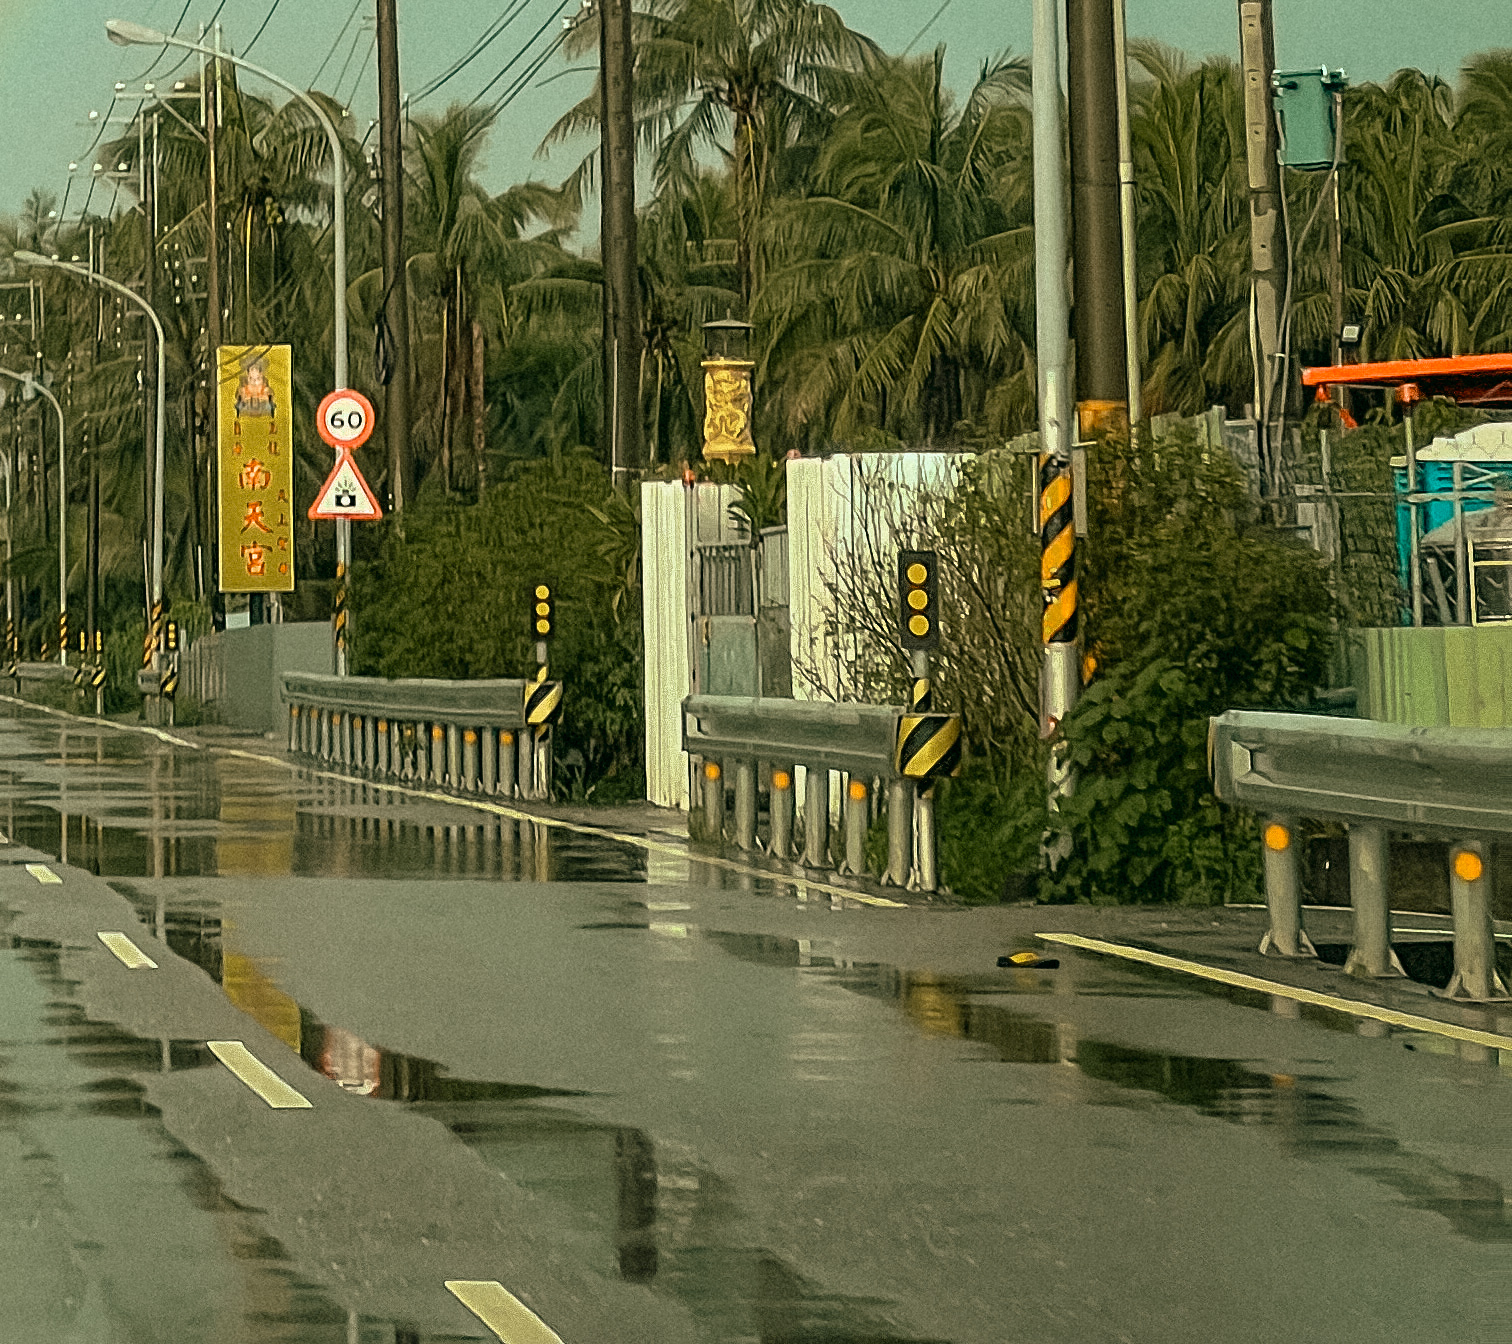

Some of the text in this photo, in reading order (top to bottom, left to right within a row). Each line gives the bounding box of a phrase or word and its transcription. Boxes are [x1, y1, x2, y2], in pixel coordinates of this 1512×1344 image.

[330, 410, 363, 429] 60
[238, 458, 273, 576] 南天宮
